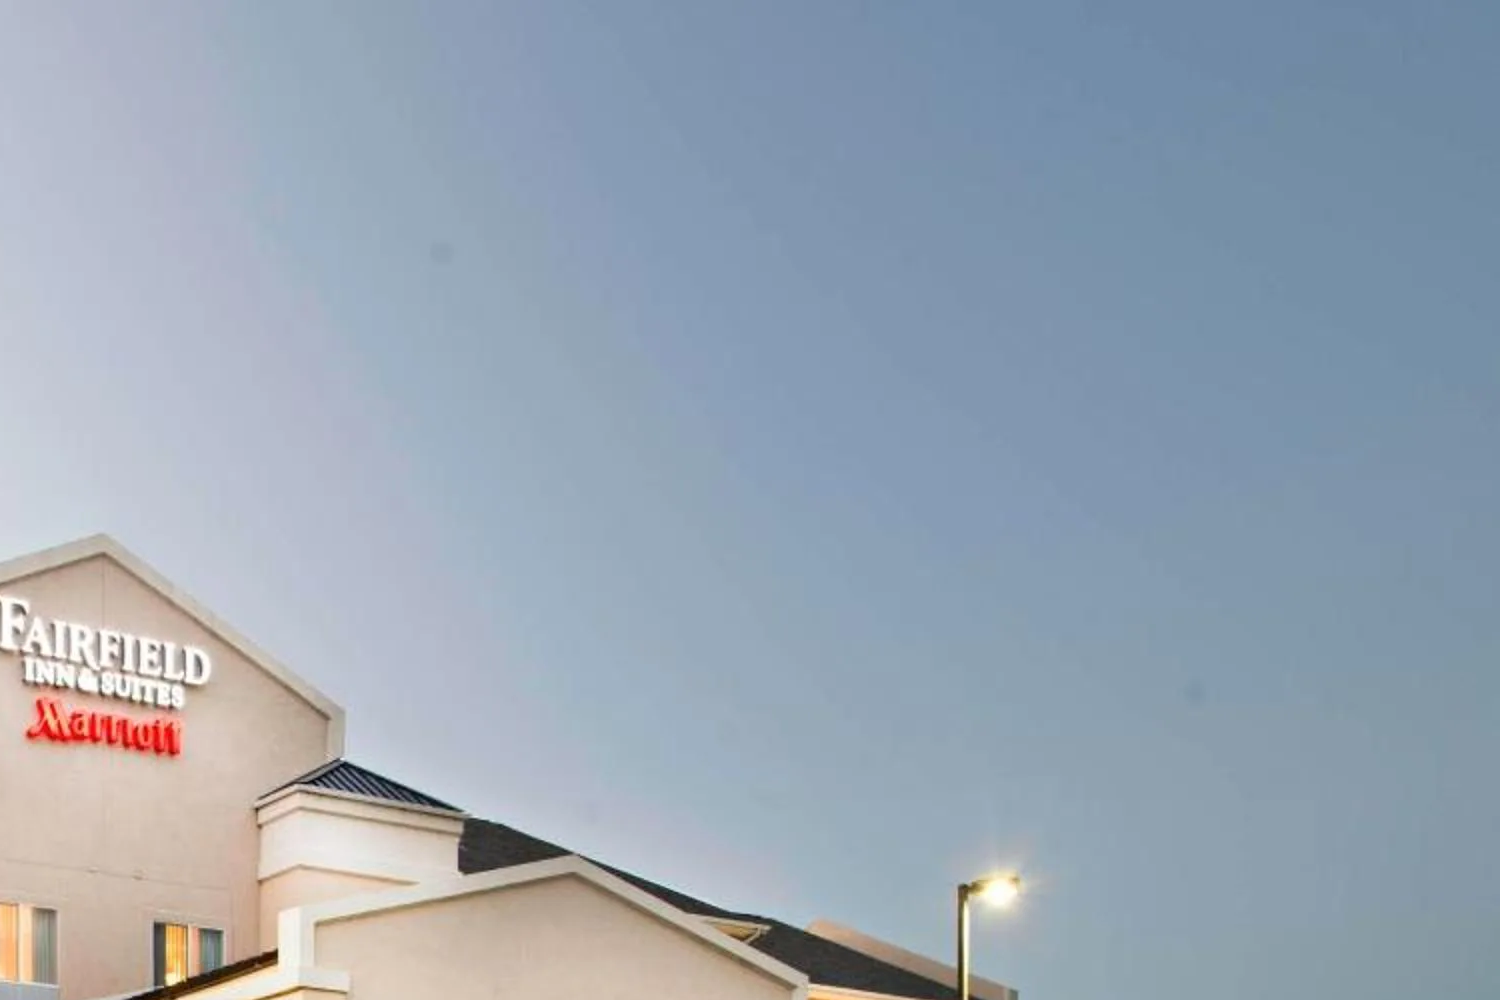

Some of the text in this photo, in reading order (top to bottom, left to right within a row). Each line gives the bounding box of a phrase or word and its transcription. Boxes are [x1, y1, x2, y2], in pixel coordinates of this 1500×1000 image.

[25, 657, 75, 688] INN
[101, 671, 185, 710] SUITES
[27, 697, 184, 756] Marriott
